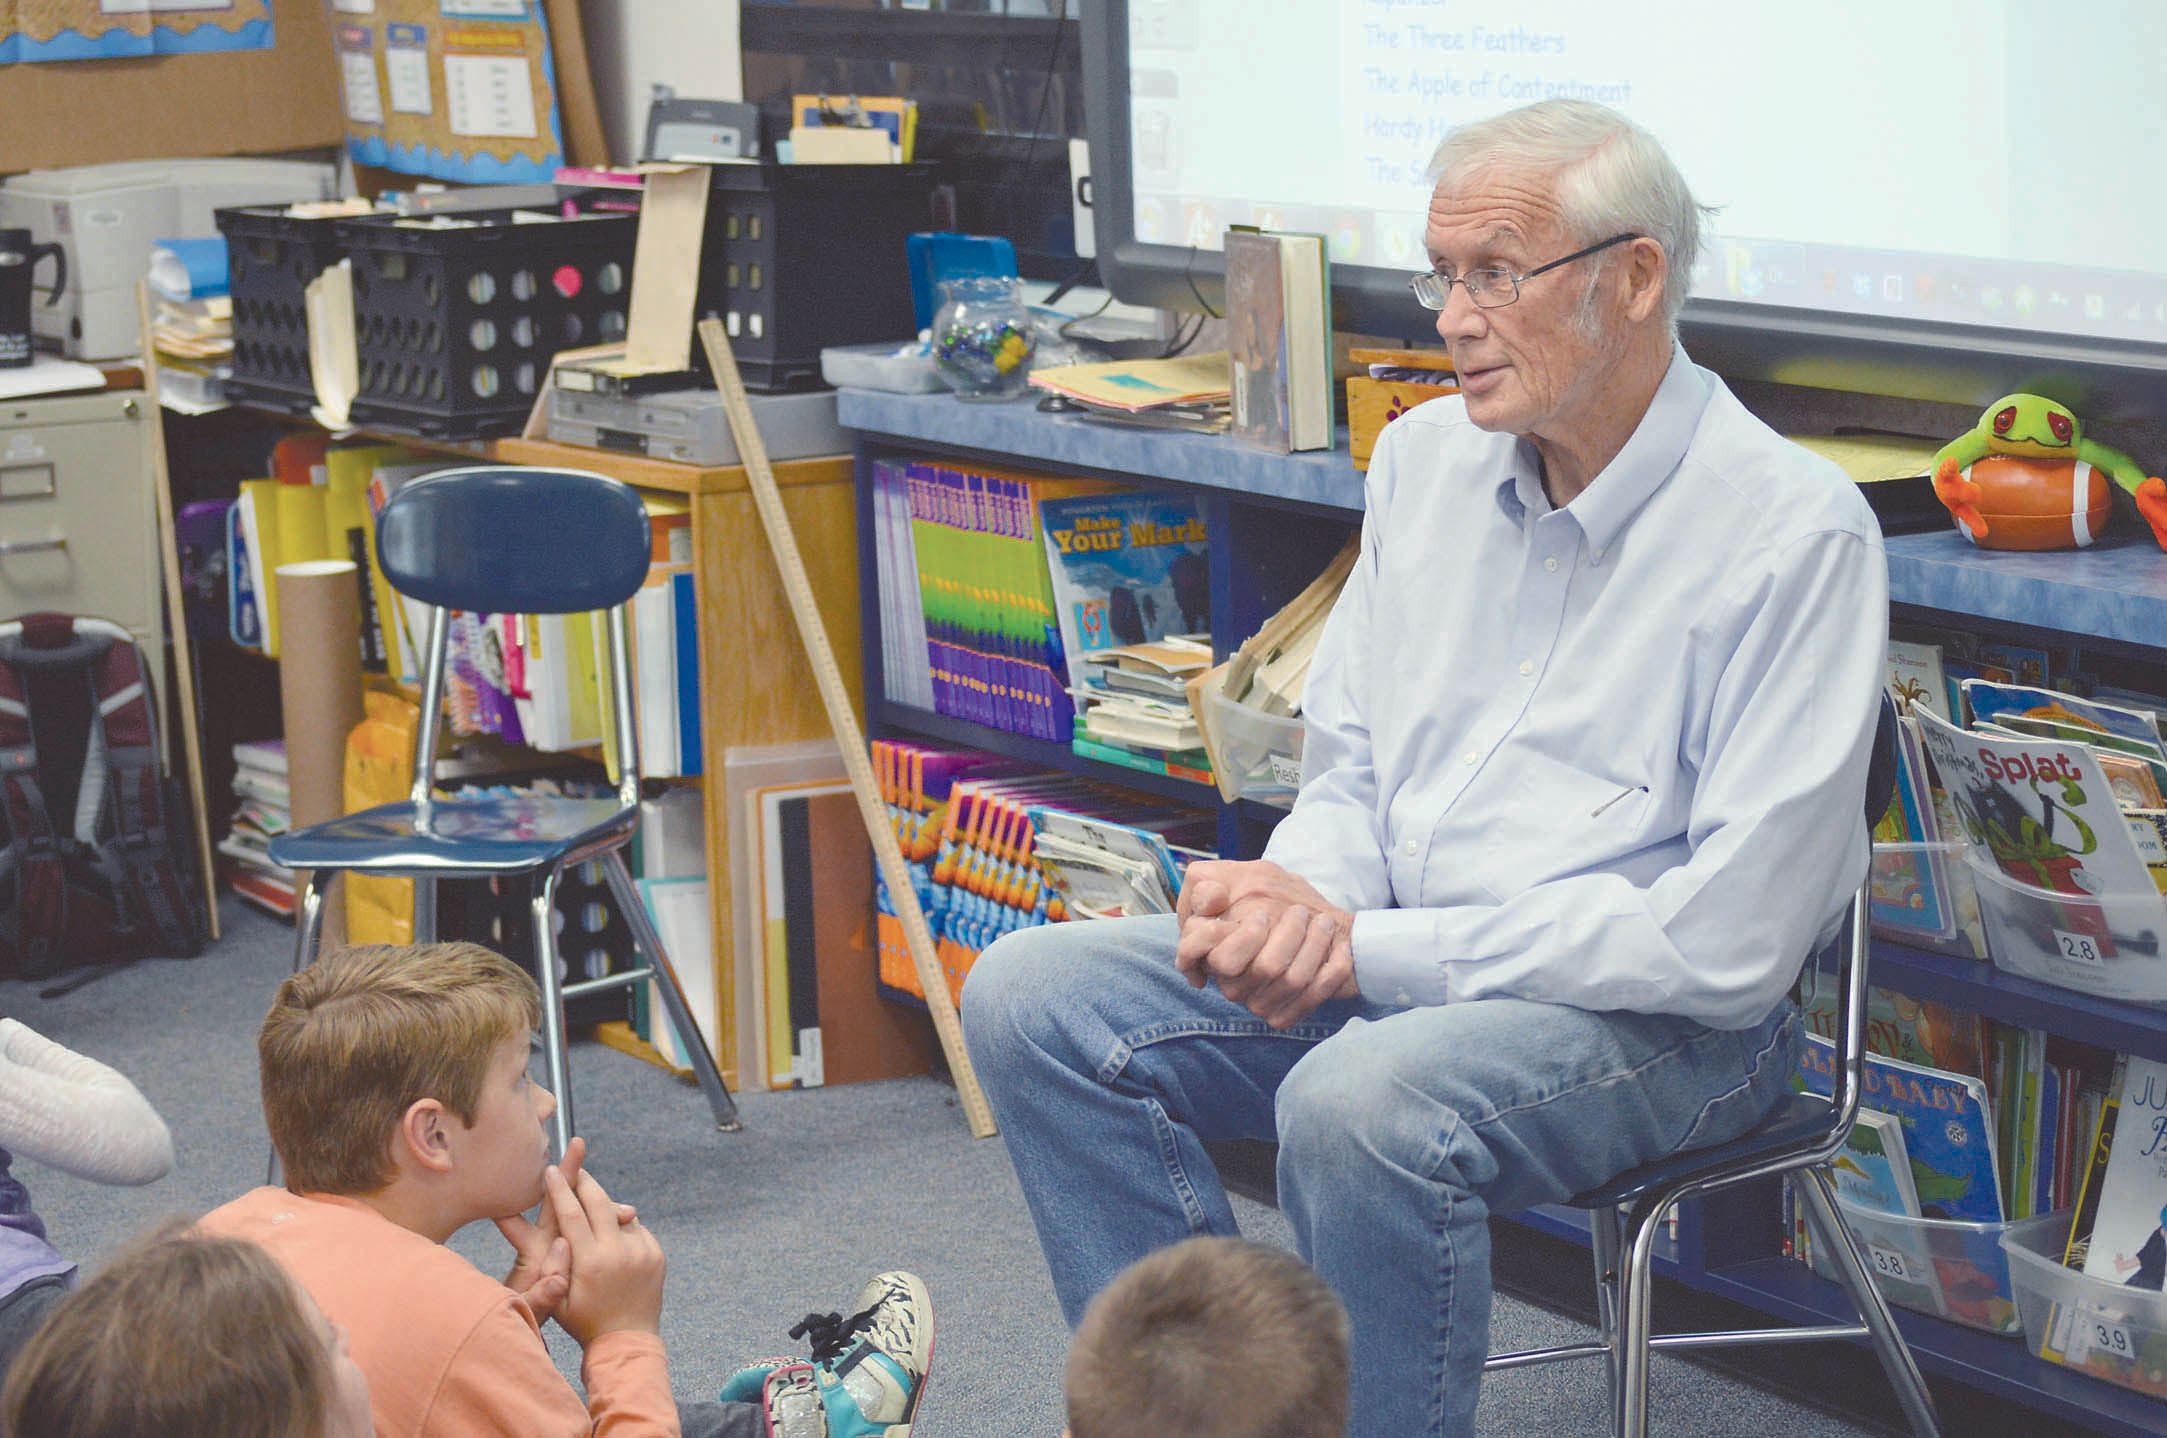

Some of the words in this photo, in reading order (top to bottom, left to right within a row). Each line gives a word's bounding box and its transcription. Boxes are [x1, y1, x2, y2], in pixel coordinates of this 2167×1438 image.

[1362, 23, 1399, 49] The
[1407, 24, 1465, 51] Three
[1472, 25, 1566, 54] Feathers
[1362, 66, 1400, 93] The
[1408, 70, 1464, 103] Apple
[1469, 71, 1493, 97] of
[1498, 72, 1633, 102] Contentment
[1364, 155, 1402, 184] The
[1053, 529, 1123, 555] Your
[1129, 518, 1208, 548] Mark
[1075, 516, 1121, 532] Make
[1978, 748, 2082, 784] Splat
[2063, 937, 2095, 960] 2.8
[1886, 1074, 1968, 1113] BABY
[1875, 1251, 1903, 1275] 3.8
[2096, 1325, 2126, 1351] 3.9
